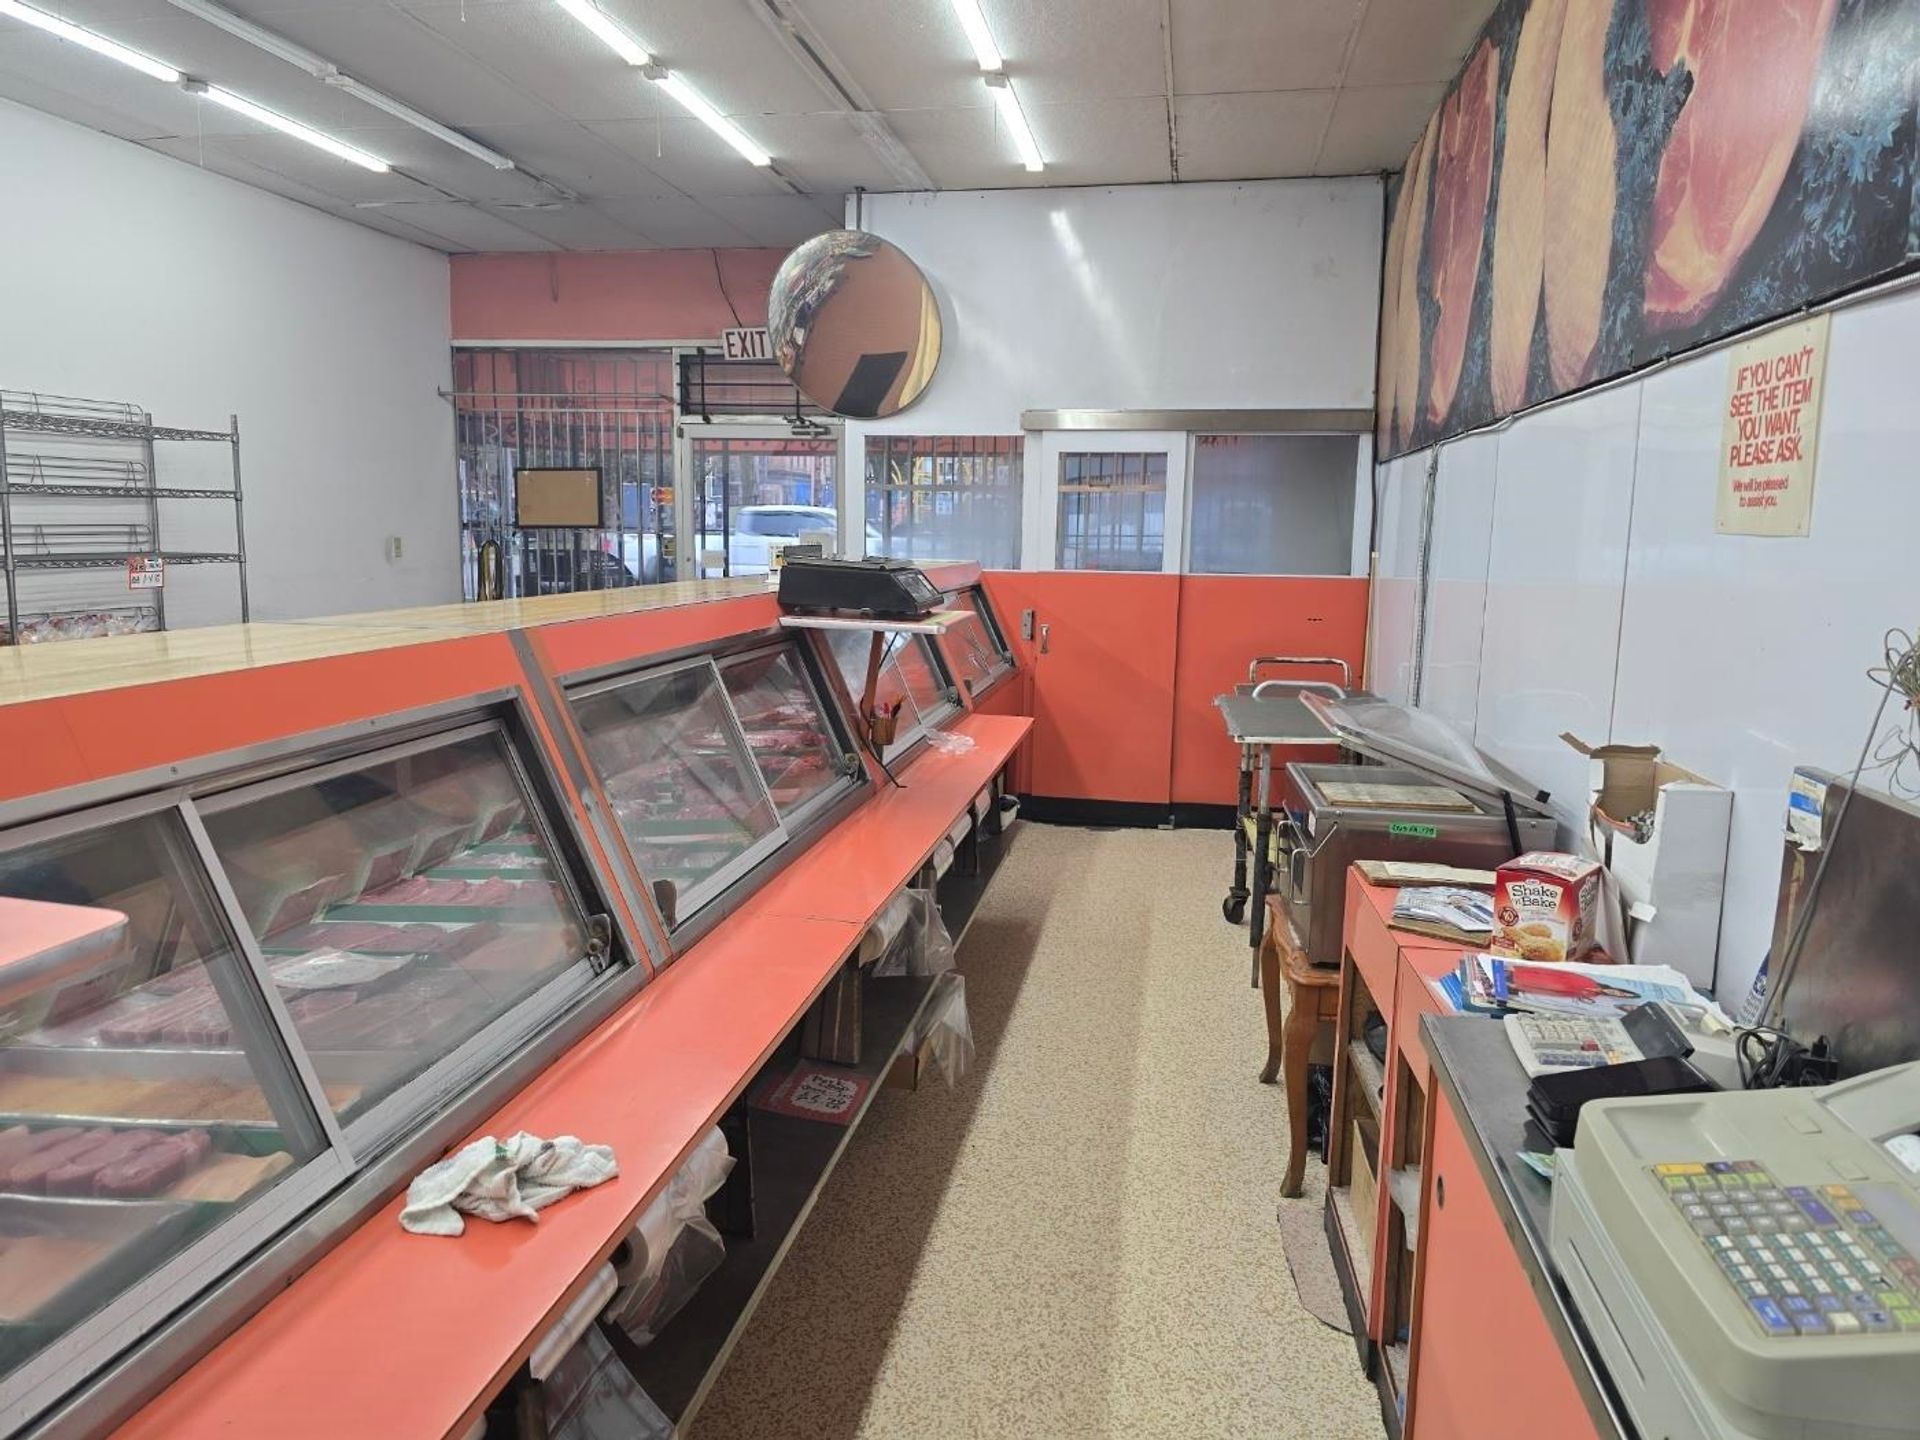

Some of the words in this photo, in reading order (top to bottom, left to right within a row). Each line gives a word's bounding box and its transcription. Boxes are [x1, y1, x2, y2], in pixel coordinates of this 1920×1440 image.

[725, 330, 766, 358] EXIT
[1737, 367, 1748, 391] IF
[1749, 359, 1772, 386] YOU
[1775, 346, 1814, 380] CAN'T
[1730, 392, 1753, 418] SEE
[1757, 384, 1779, 413] THE
[1781, 377, 1813, 407] ITEM
[1738, 416, 1762, 442] YOU
[1730, 440, 1775, 467] PLEASE
[1775, 436, 1803, 463] ASK.
[1511, 884, 1558, 898] Shake
[1522, 897, 1557, 909] Bake
